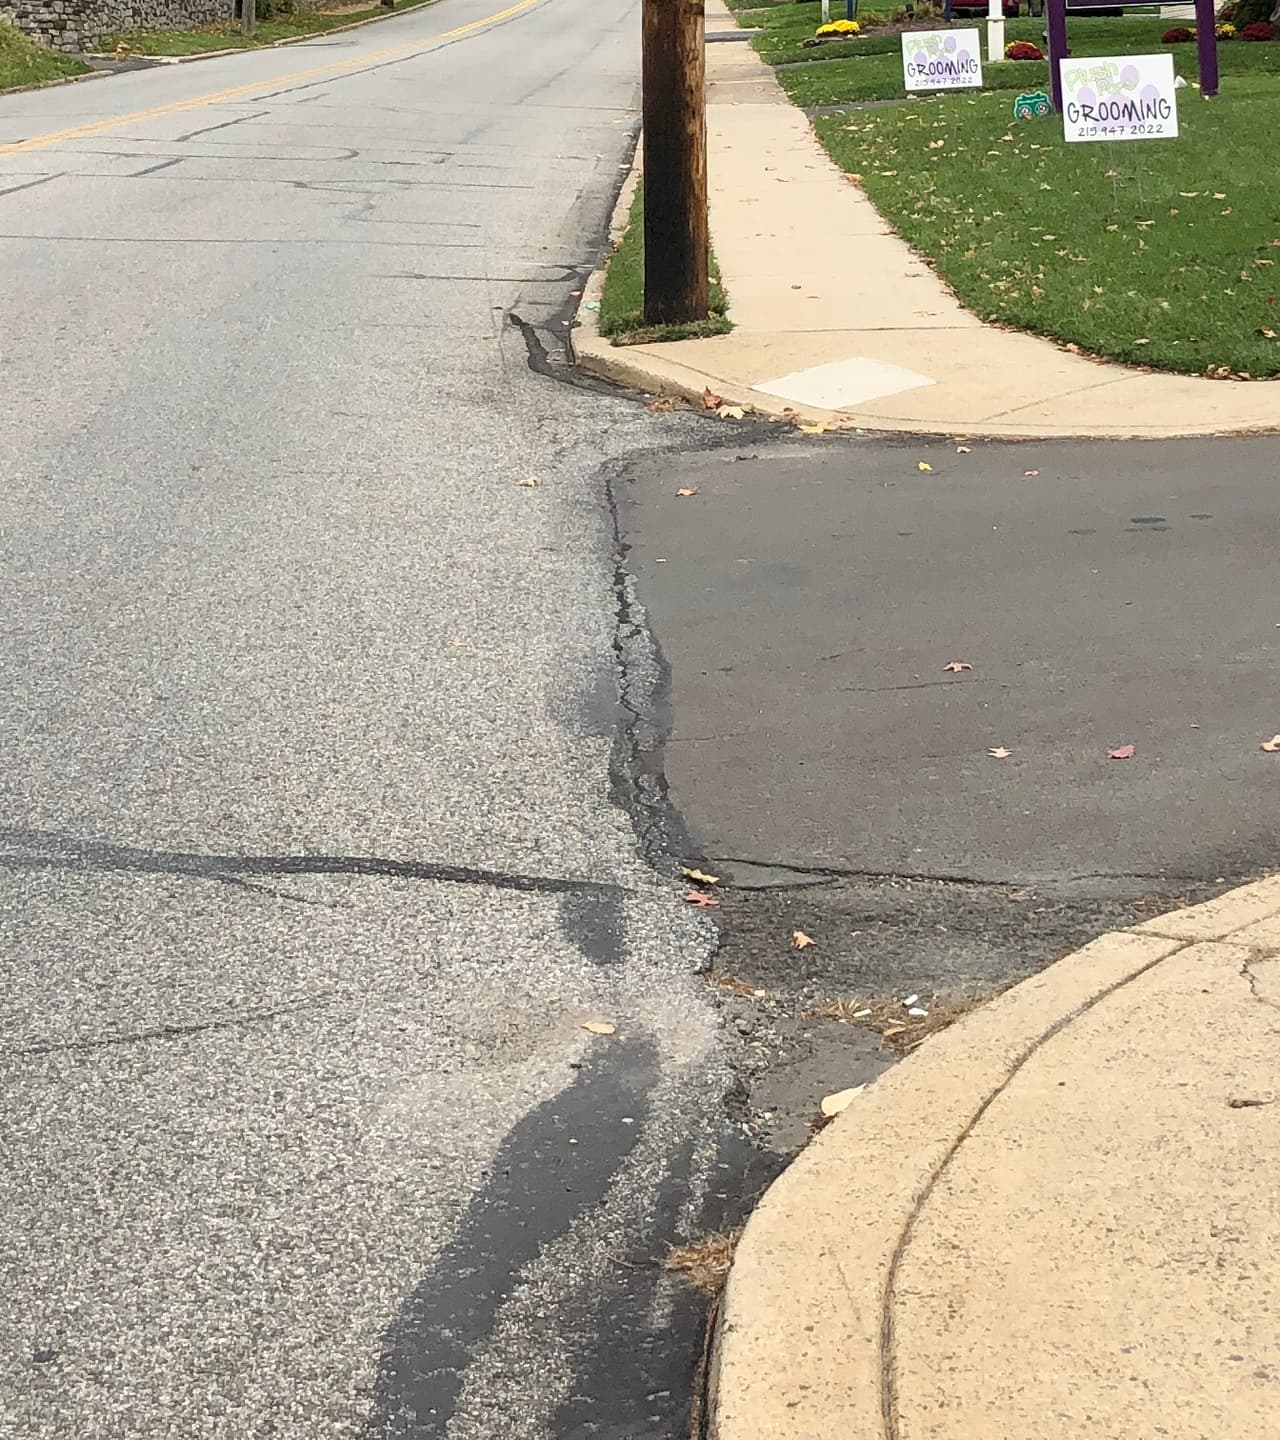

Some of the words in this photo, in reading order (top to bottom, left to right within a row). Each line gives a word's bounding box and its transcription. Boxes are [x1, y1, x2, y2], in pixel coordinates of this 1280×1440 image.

[907, 58, 978, 78] GROOMING
[1067, 98, 1171, 124] GROOMING
[1078, 126, 1098, 137] 215
[1101, 125, 1126, 137] 947
[1130, 123, 1164, 135] 2022
